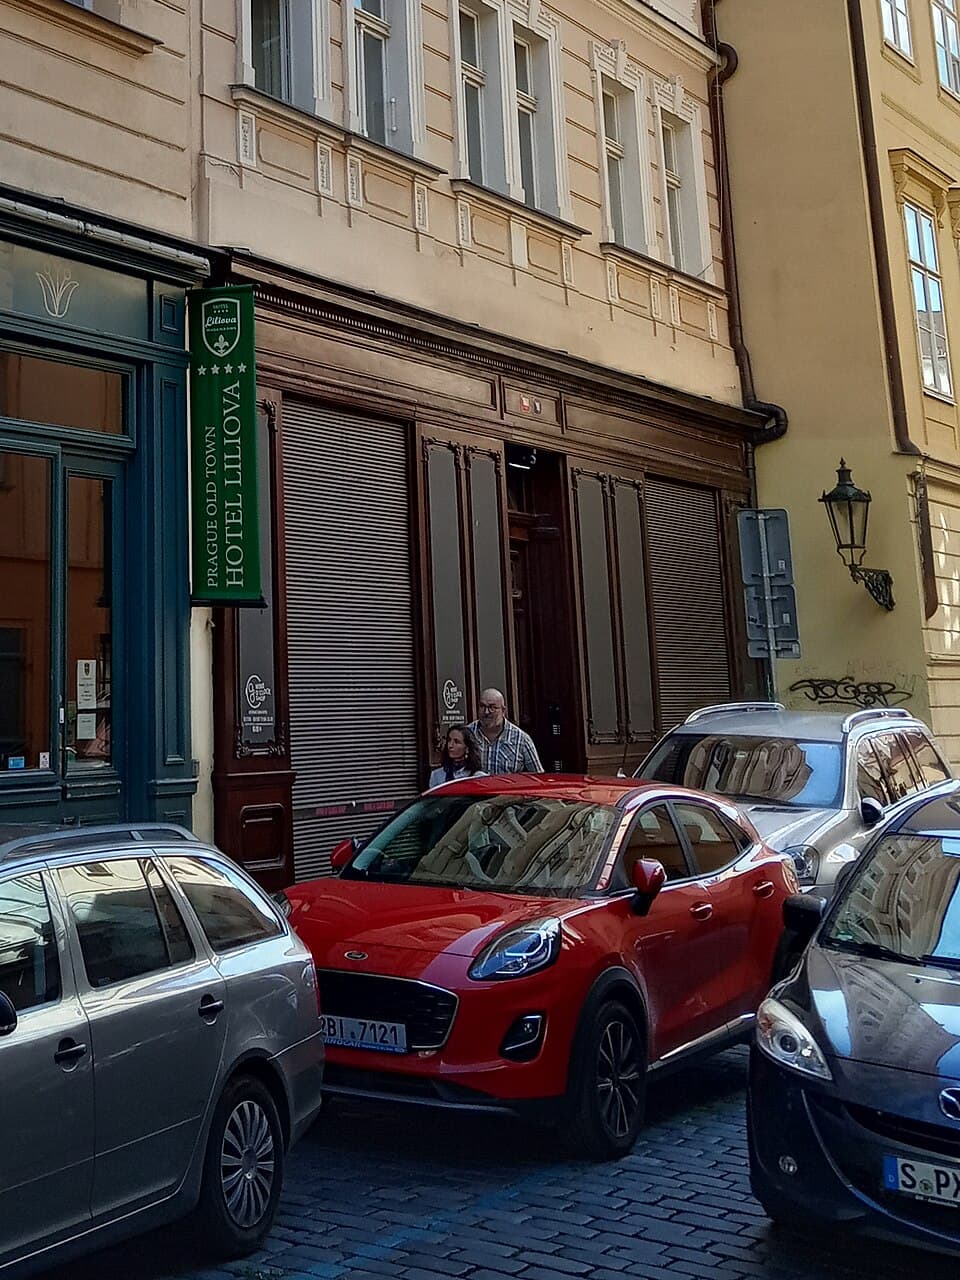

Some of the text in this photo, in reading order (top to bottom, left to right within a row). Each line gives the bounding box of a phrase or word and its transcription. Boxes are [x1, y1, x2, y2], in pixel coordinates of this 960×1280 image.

[205, 425, 218, 588] PRAGUE OLD TOWN
[222, 380, 244, 588] HOTEL LILIOVA
[358, 1021, 399, 1046] 7121
